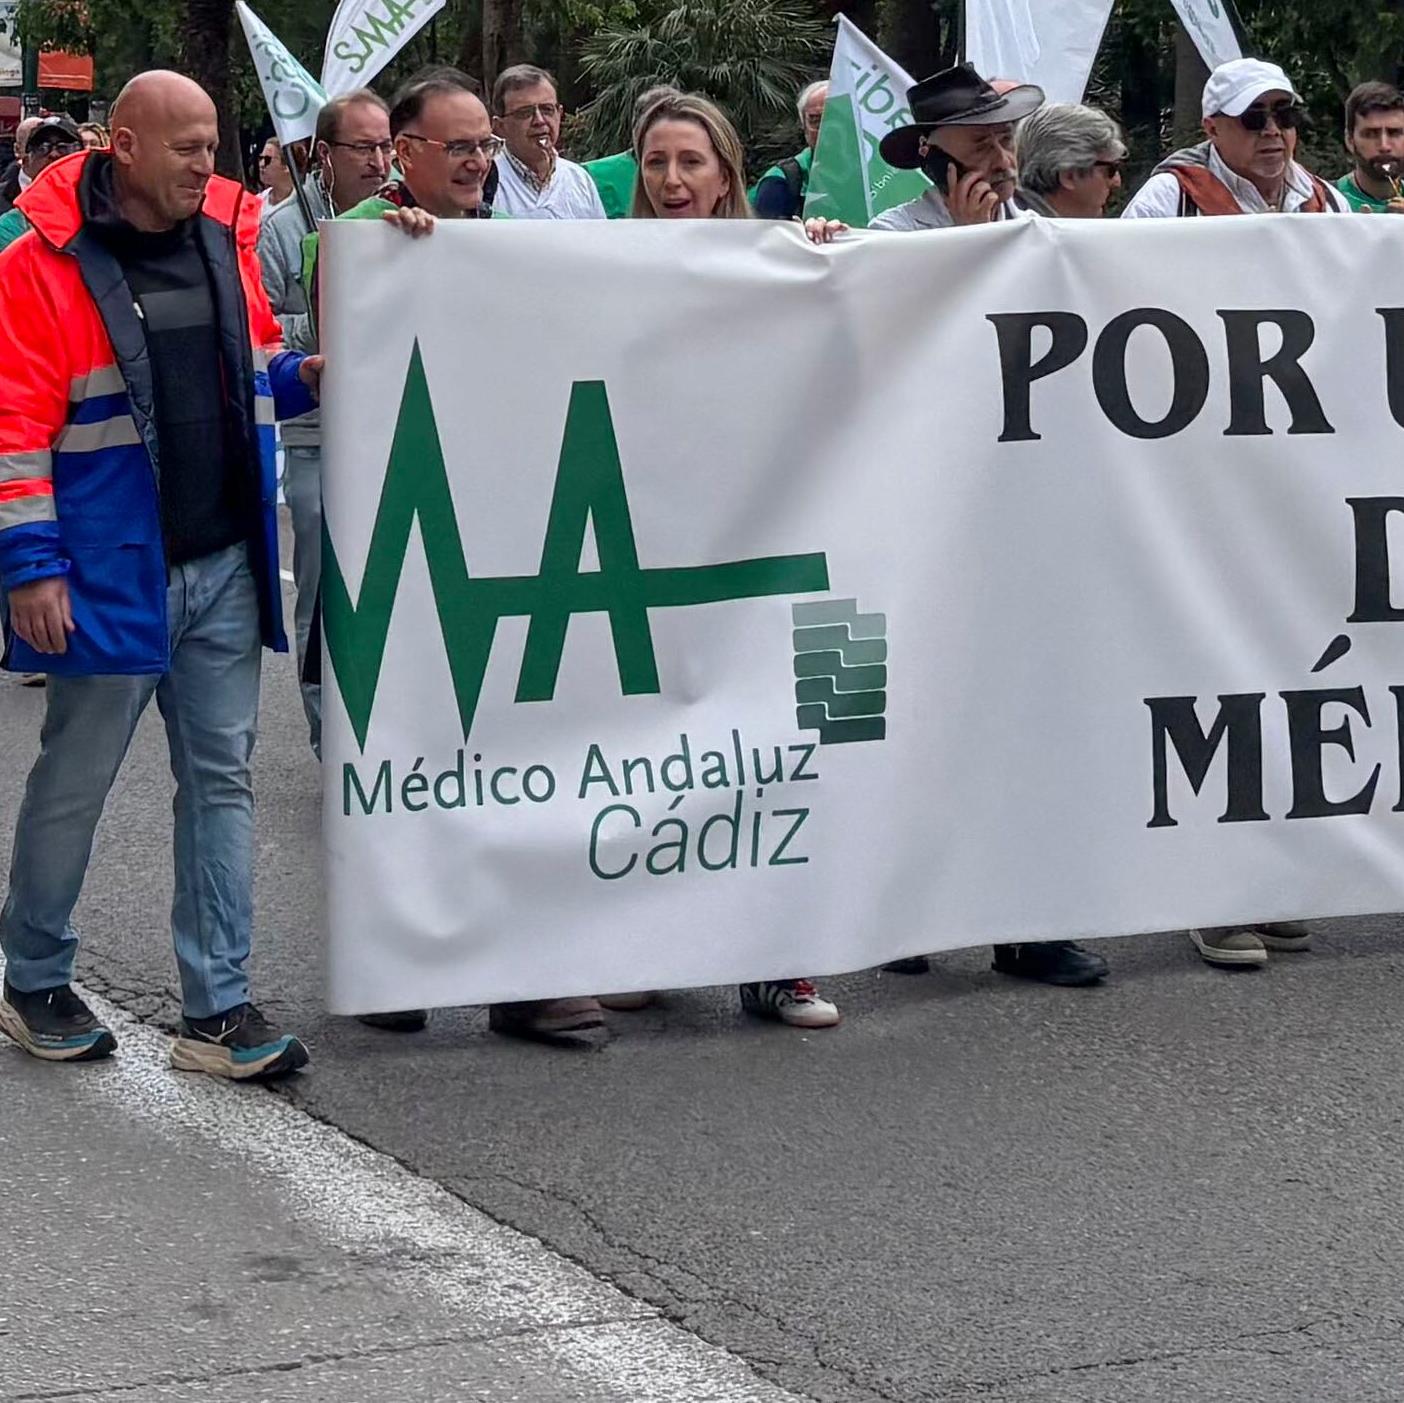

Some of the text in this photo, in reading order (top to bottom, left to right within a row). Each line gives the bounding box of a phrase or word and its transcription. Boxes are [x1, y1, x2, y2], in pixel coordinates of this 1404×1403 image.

[985, 307, 1336, 442] POR
[342, 728, 819, 817] Médico Andaluz
[587, 788, 812, 880] Cádiz
